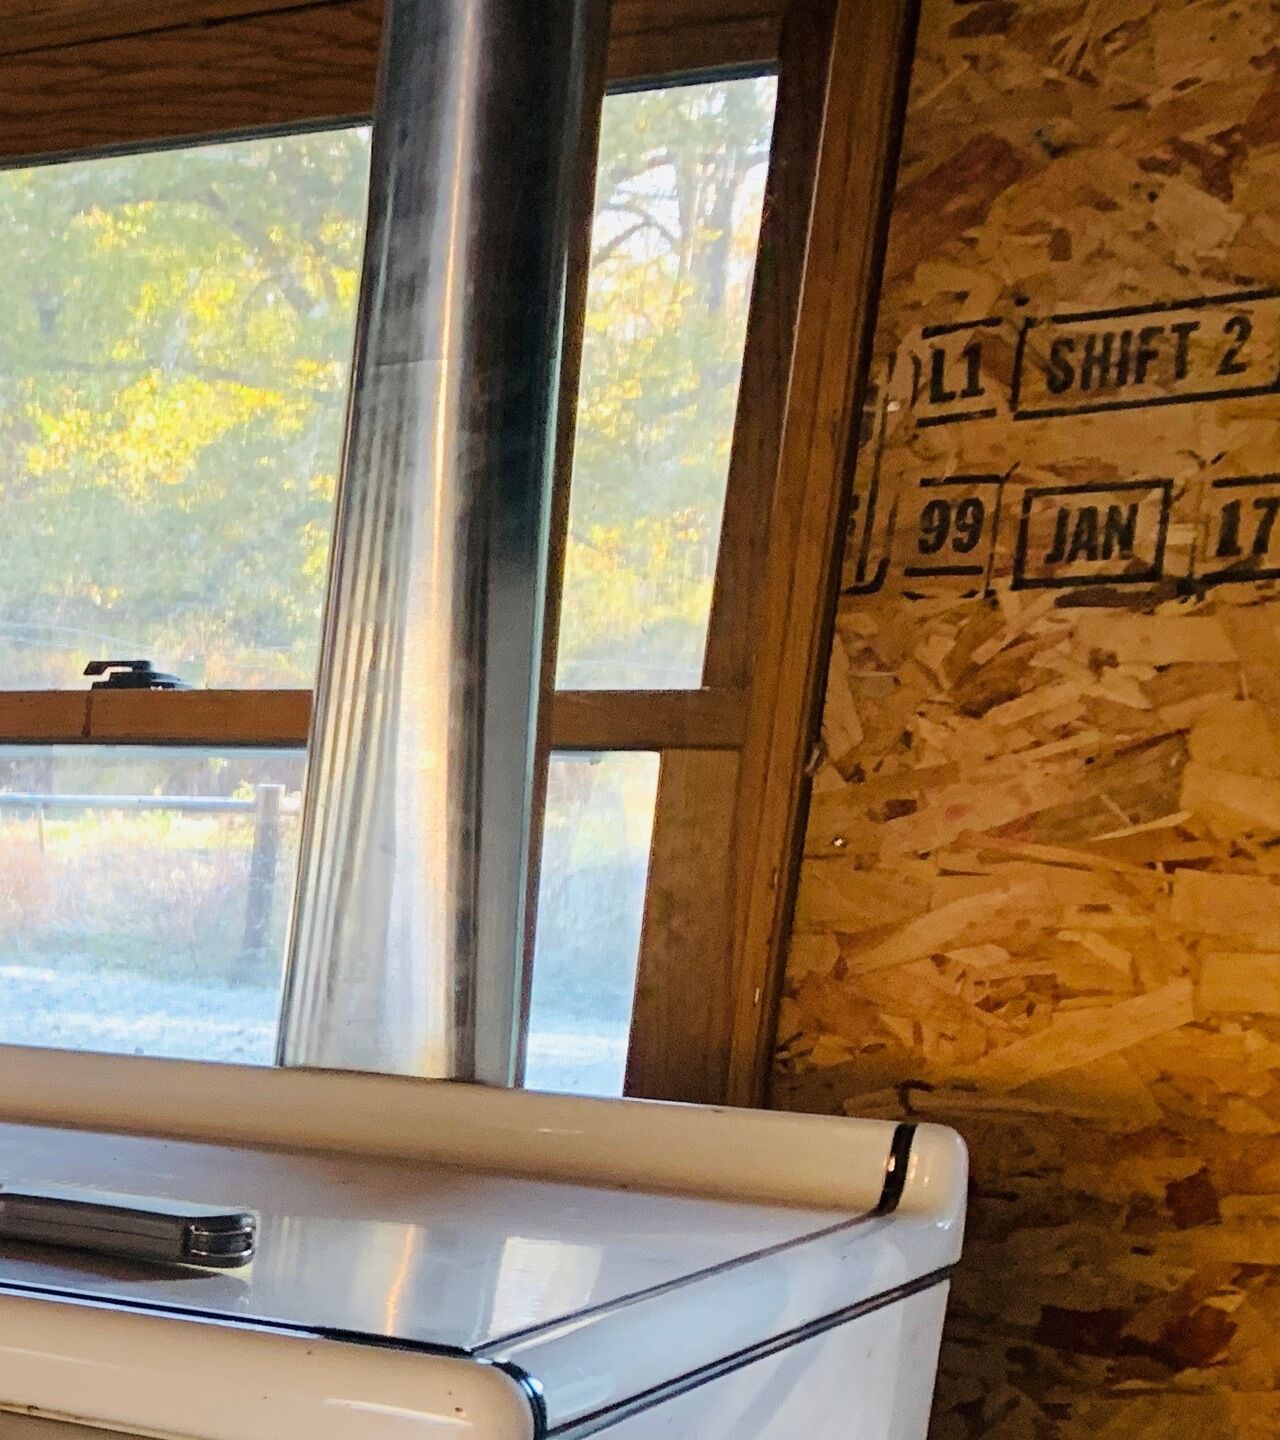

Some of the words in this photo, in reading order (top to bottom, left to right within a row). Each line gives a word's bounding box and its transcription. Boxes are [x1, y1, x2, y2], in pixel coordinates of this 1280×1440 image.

[928, 342, 986, 404] L1
[1045, 321, 1201, 396] SHIFT
[1215, 315, 1254, 377] 2
[917, 496, 986, 556] 99
[1044, 503, 1140, 565] JAN
[1215, 496, 1280, 558] 17
